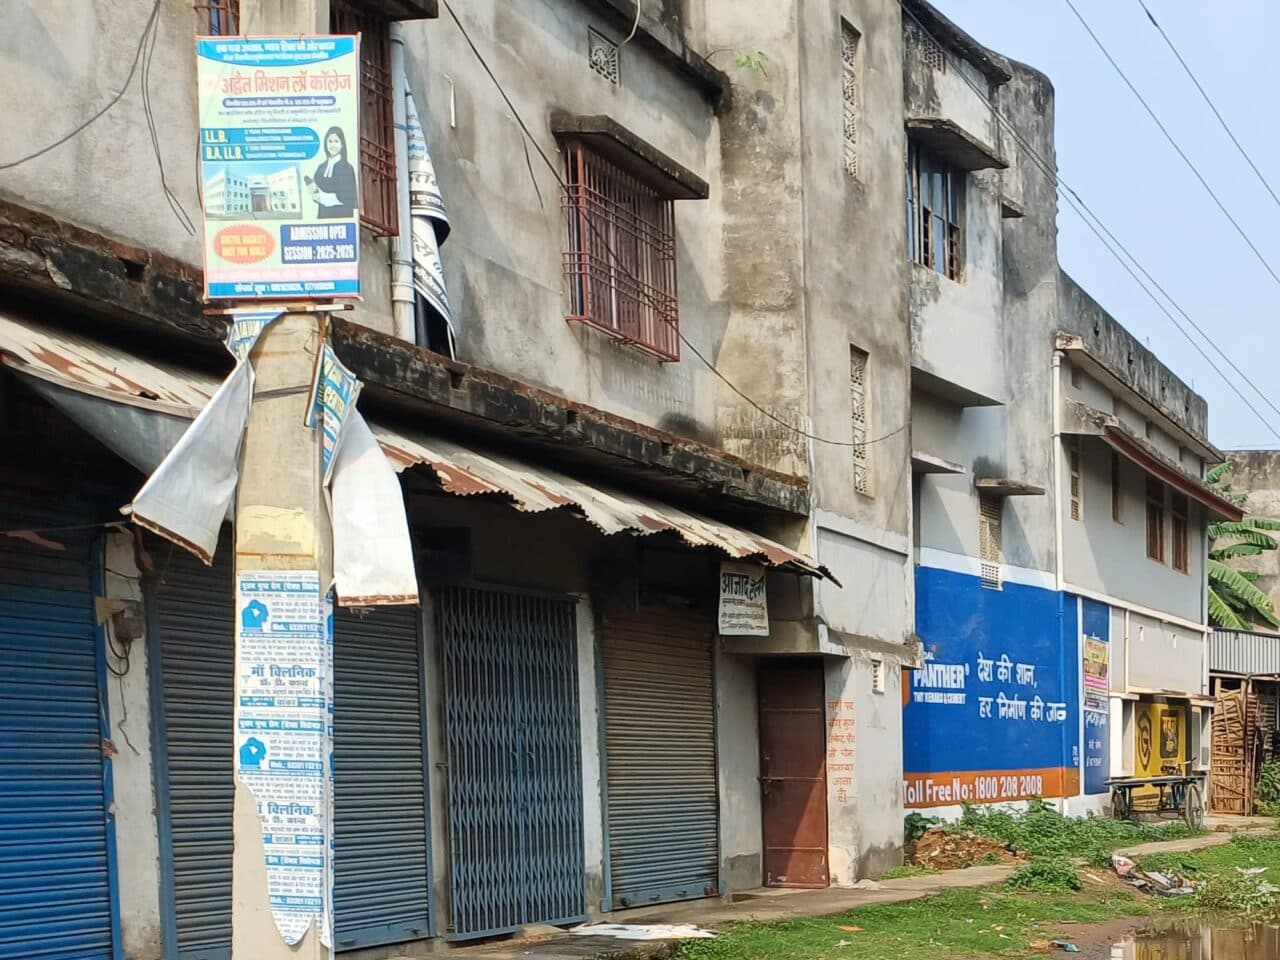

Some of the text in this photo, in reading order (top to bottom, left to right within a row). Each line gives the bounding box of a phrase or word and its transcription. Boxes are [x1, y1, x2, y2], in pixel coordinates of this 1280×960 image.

[222, 70, 251, 95] अद्वैत
[254, 69, 290, 93] मिशन
[309, 69, 351, 93] कॉलेज
[290, 225, 347, 241] ADMISSION OPEN
[284, 246, 313, 260] SESSION
[317, 244, 354, 260] 2025-2026
[721, 572, 749, 596] आजाद
[269, 664, 317, 678] क्लिनिक
[913, 663, 965, 689] PANTHER
[977, 650, 1038, 689] देश की शान,
[978, 697, 994, 718] हर
[997, 691, 1026, 720] निर्माण
[1030, 695, 1044, 721] की
[902, 775, 1043, 804] Toll Free No: 1800 208 2008
[268, 801, 314, 816] क्लिनिक
